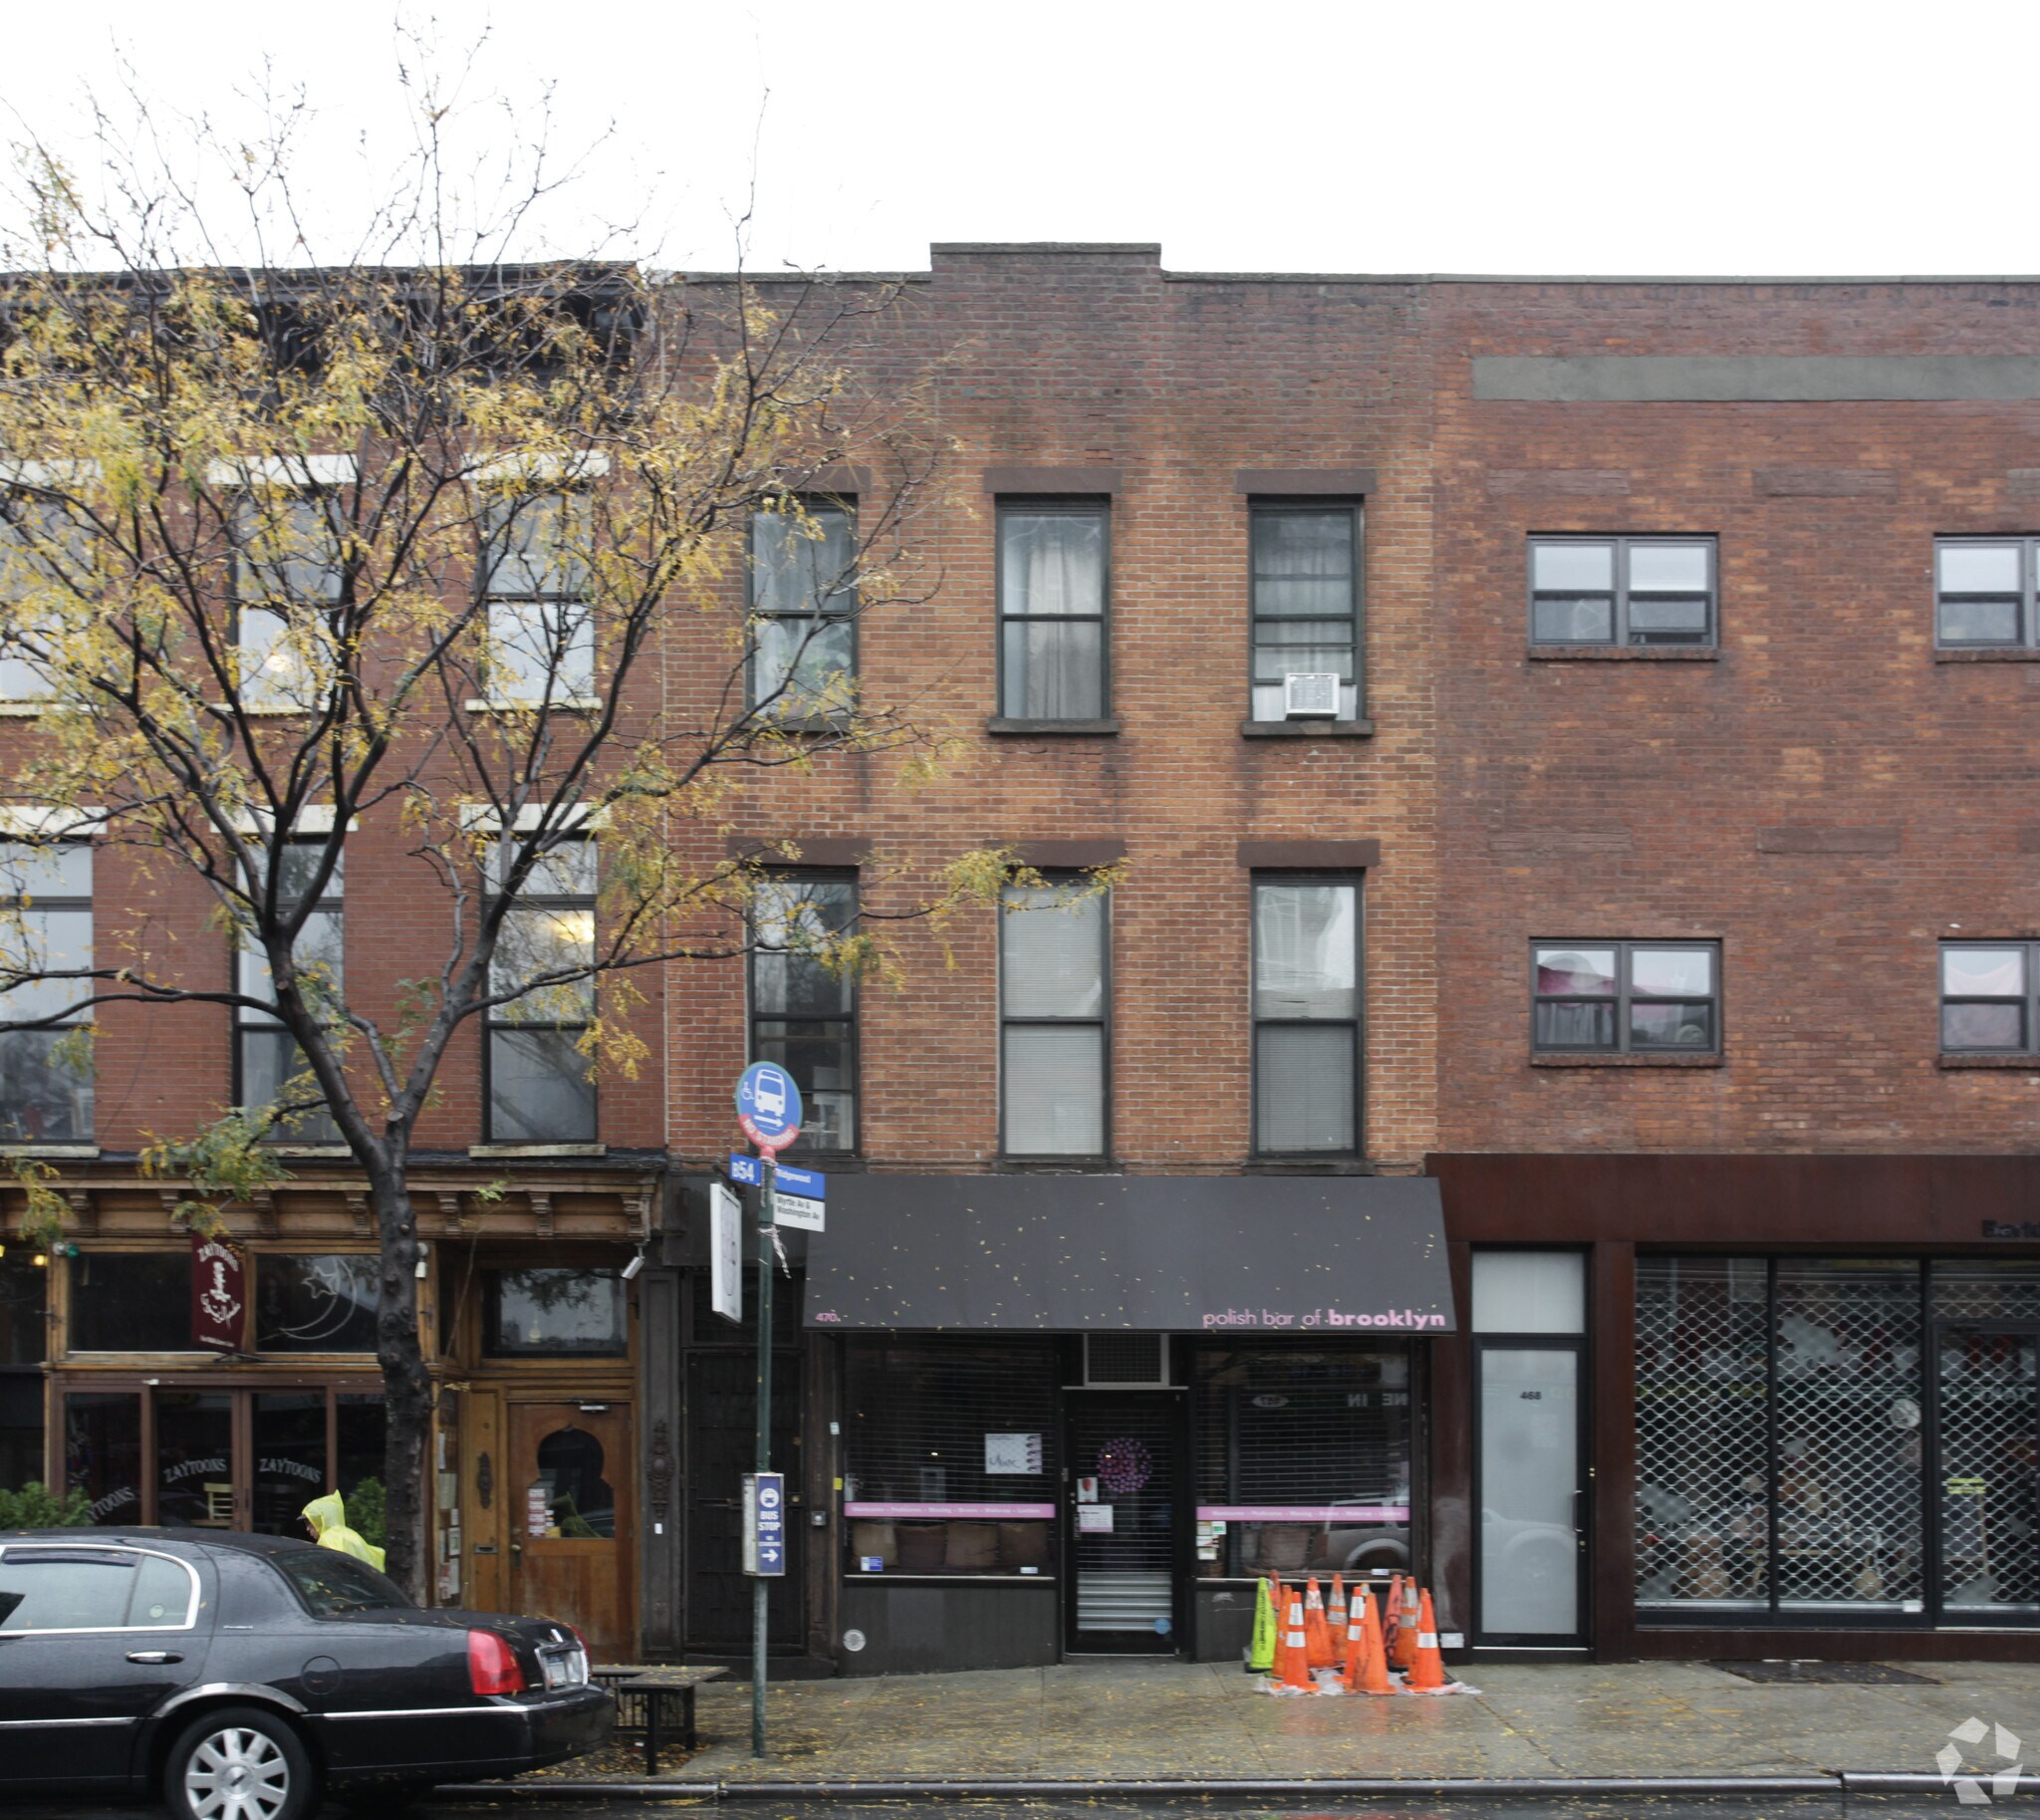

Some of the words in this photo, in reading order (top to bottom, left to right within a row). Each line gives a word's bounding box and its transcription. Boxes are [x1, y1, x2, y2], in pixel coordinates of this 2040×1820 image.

[732, 1162, 754, 1181] B54
[815, 1312, 838, 1323] 470
[1202, 1308, 1257, 1329] polish
[1262, 1308, 1295, 1326] bar
[1302, 1308, 1323, 1326] of
[1328, 1309, 1445, 1331] brooklyn
[162, 1457, 227, 1483] ZAYTOONS
[259, 1457, 323, 1484] ZAYTOONS
[86, 1485, 135, 1521] YTOONS
[760, 1510, 779, 1520] BUS
[758, 1521, 781, 1531] STOP
